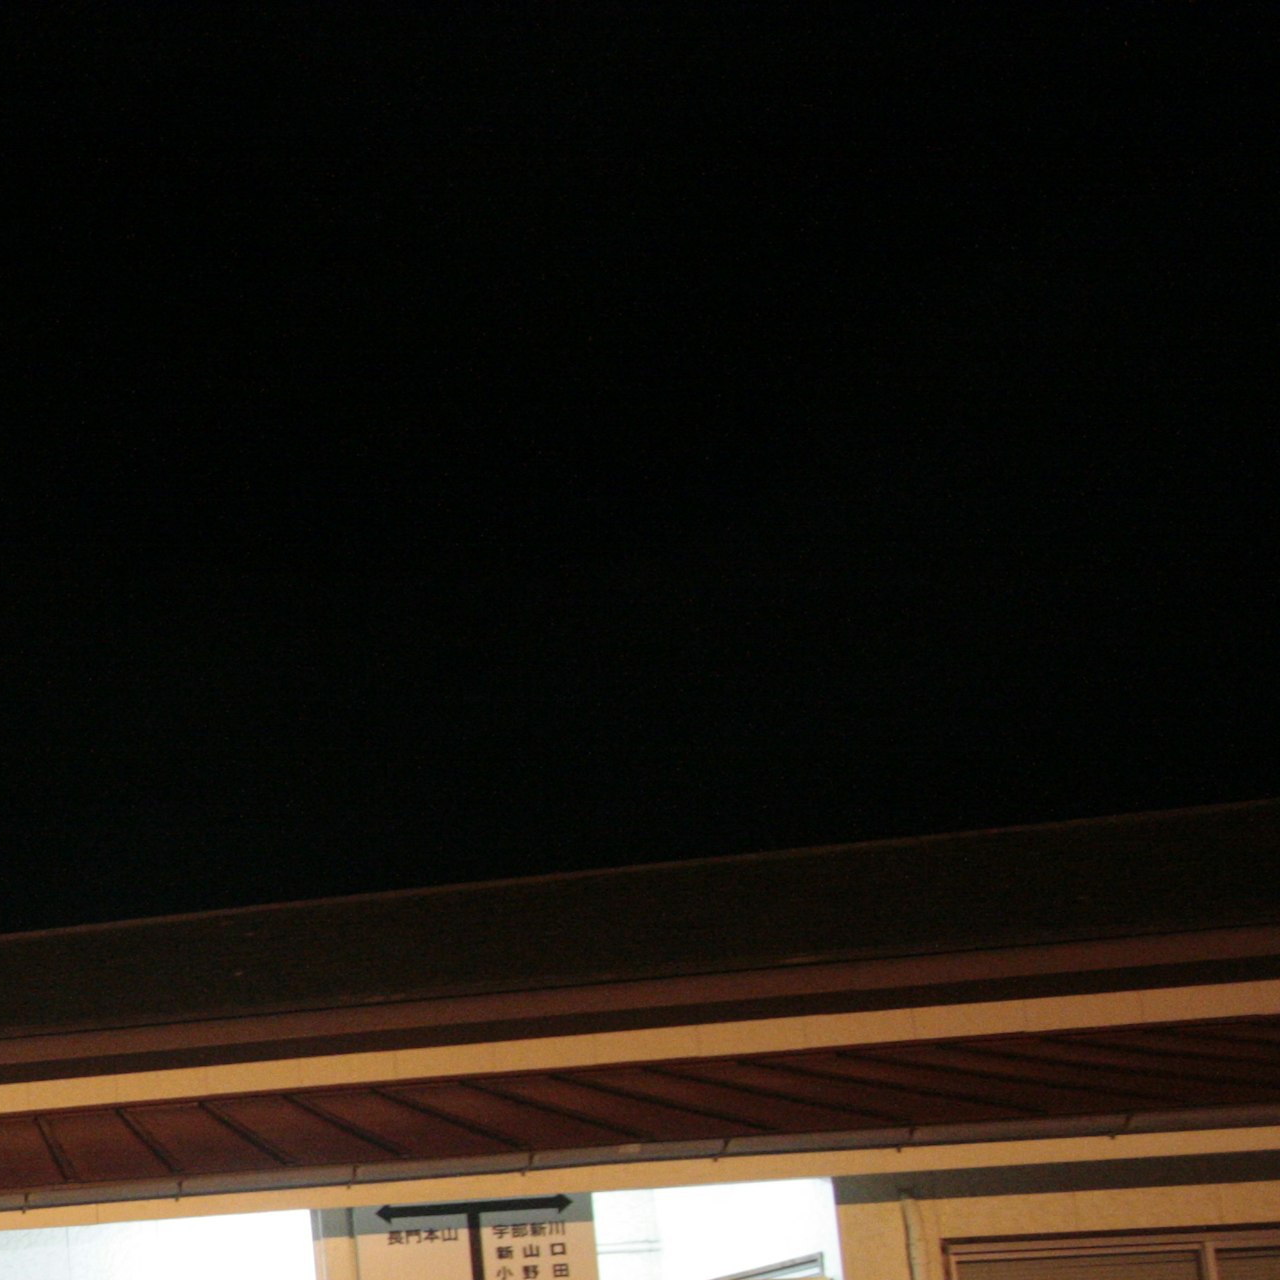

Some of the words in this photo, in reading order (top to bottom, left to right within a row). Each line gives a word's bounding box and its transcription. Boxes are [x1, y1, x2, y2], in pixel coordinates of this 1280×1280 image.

[387, 1227, 459, 1246] 長門本山
[492, 1221, 566, 1240] 宇部新川
[495, 1242, 567, 1260] 新山口
[496, 1263, 570, 1280] 小野田
